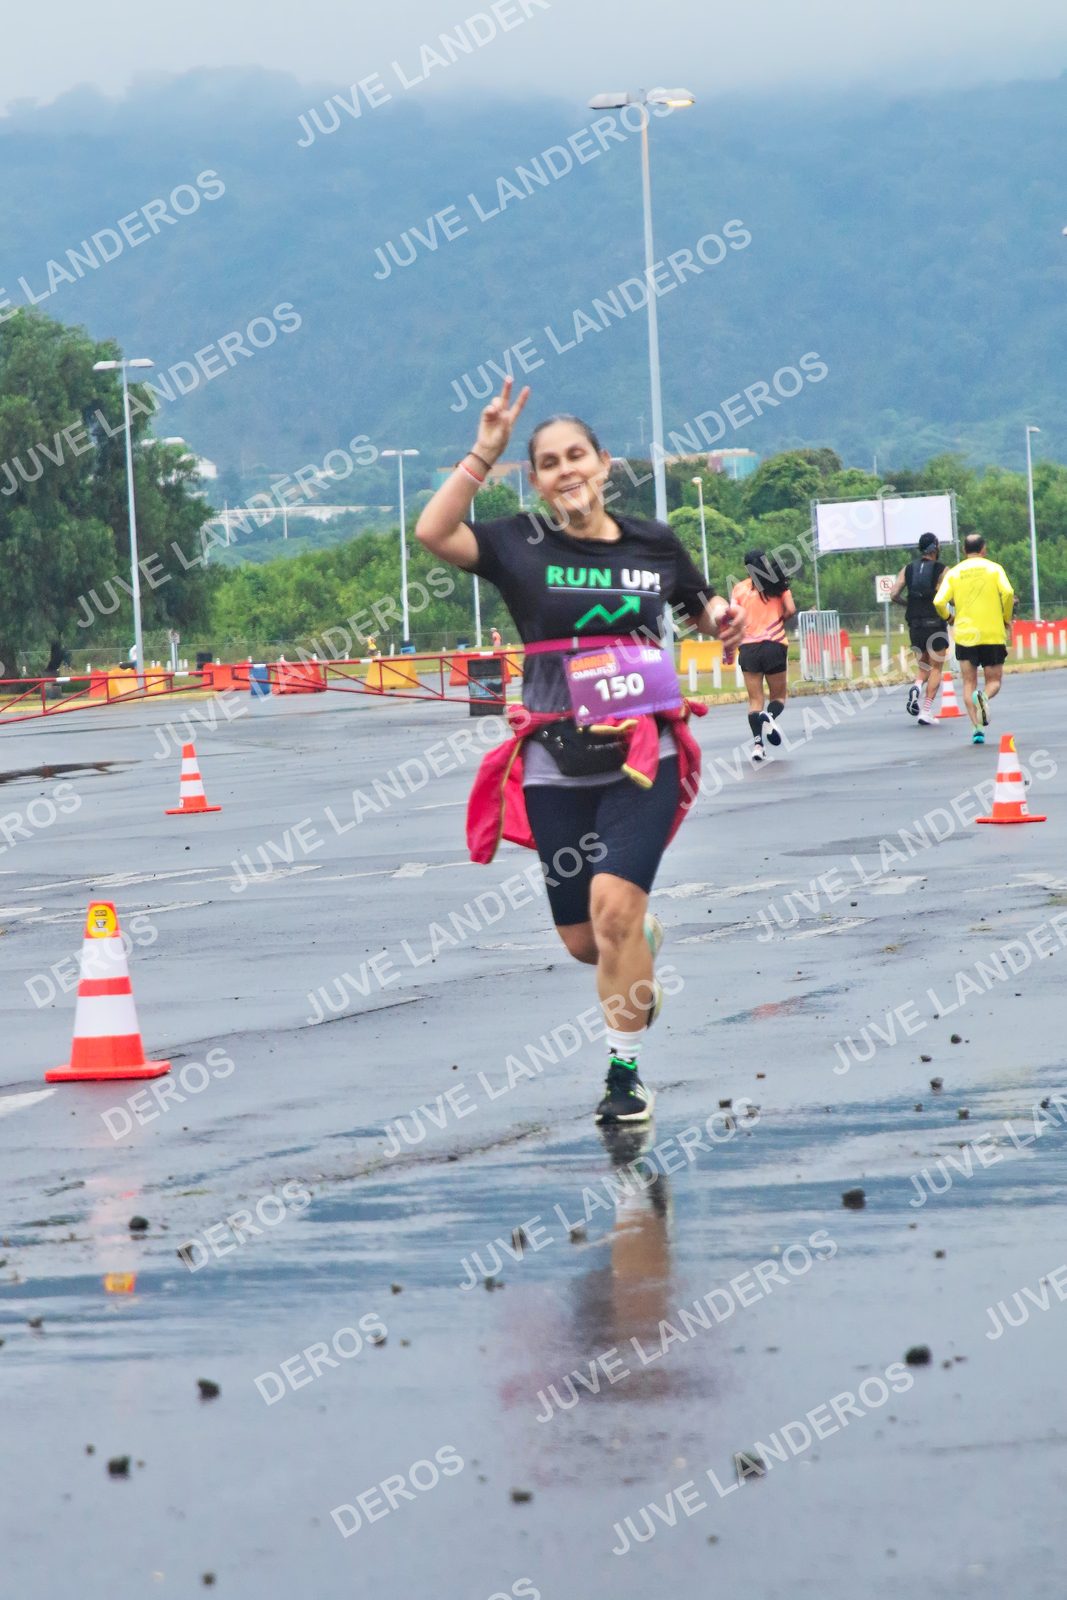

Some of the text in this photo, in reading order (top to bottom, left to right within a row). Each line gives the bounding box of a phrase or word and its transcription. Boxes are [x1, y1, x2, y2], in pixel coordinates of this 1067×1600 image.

[546, 565, 661, 591] RUN UP!
[595, 672, 645, 701] 150
